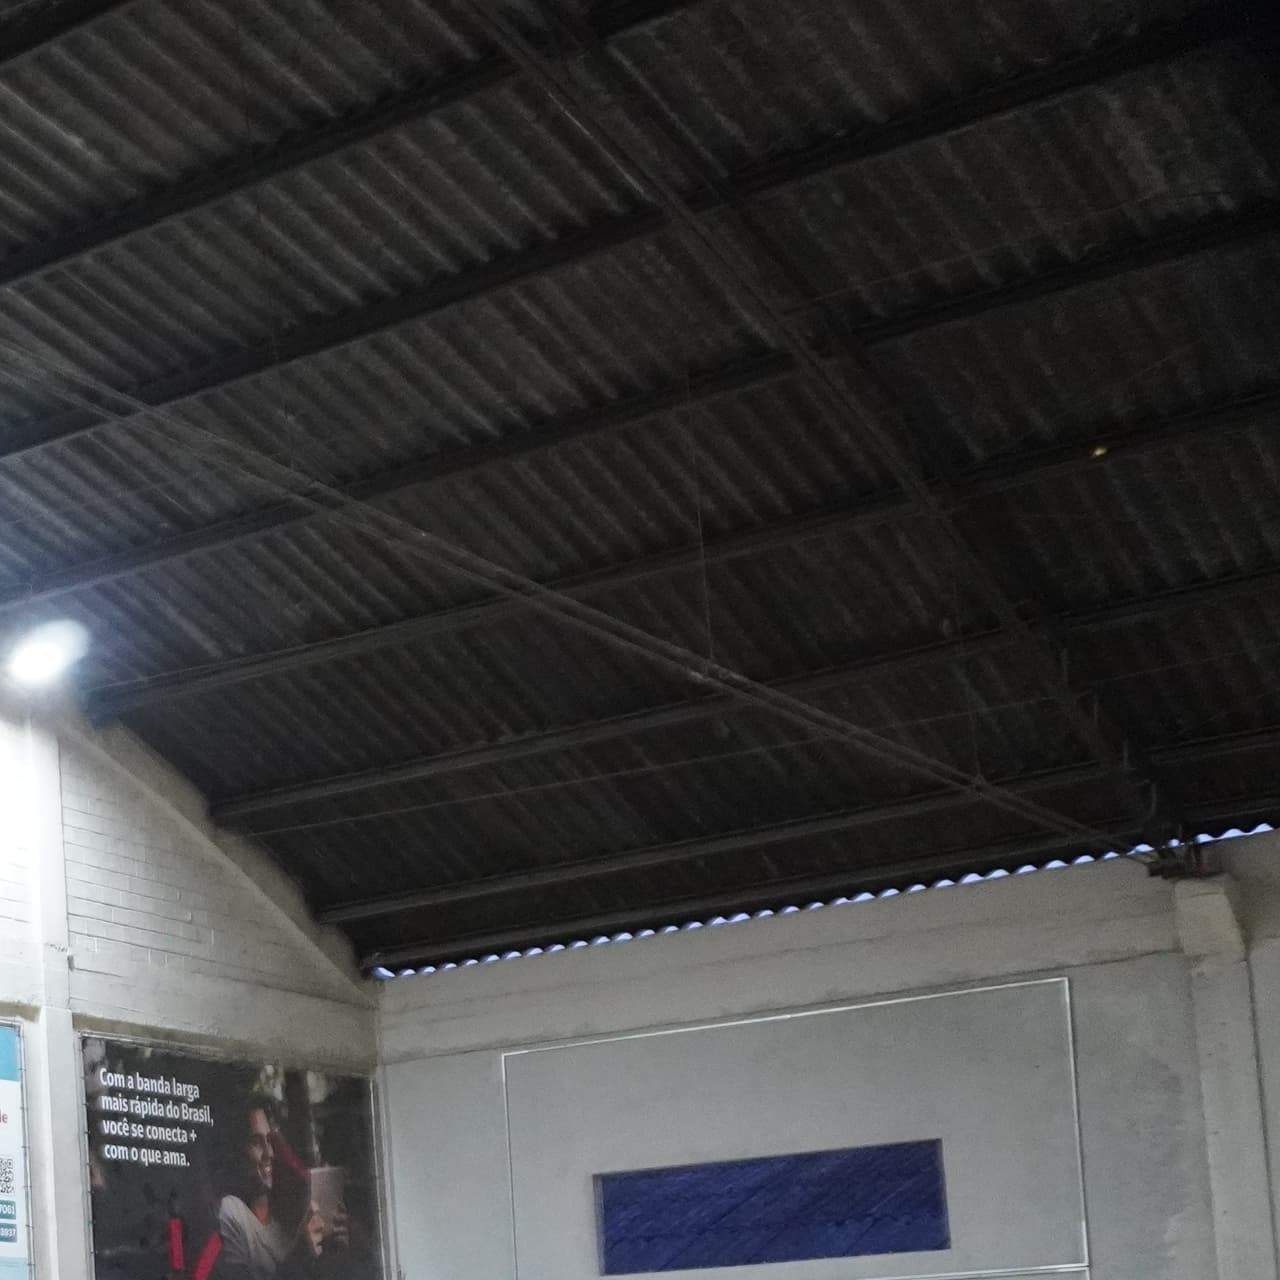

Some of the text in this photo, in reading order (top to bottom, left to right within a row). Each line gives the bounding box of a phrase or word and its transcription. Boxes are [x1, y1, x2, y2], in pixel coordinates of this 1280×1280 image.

[100, 1067, 200, 1101] Com a banda larga
[101, 1093, 214, 1127] mais rápida do Brasil,
[103, 1118, 130, 1136] você
[132, 1122, 144, 1138] se
[146, 1123, 188, 1144] conecta
[104, 1144, 190, 1168] com o que ama.
